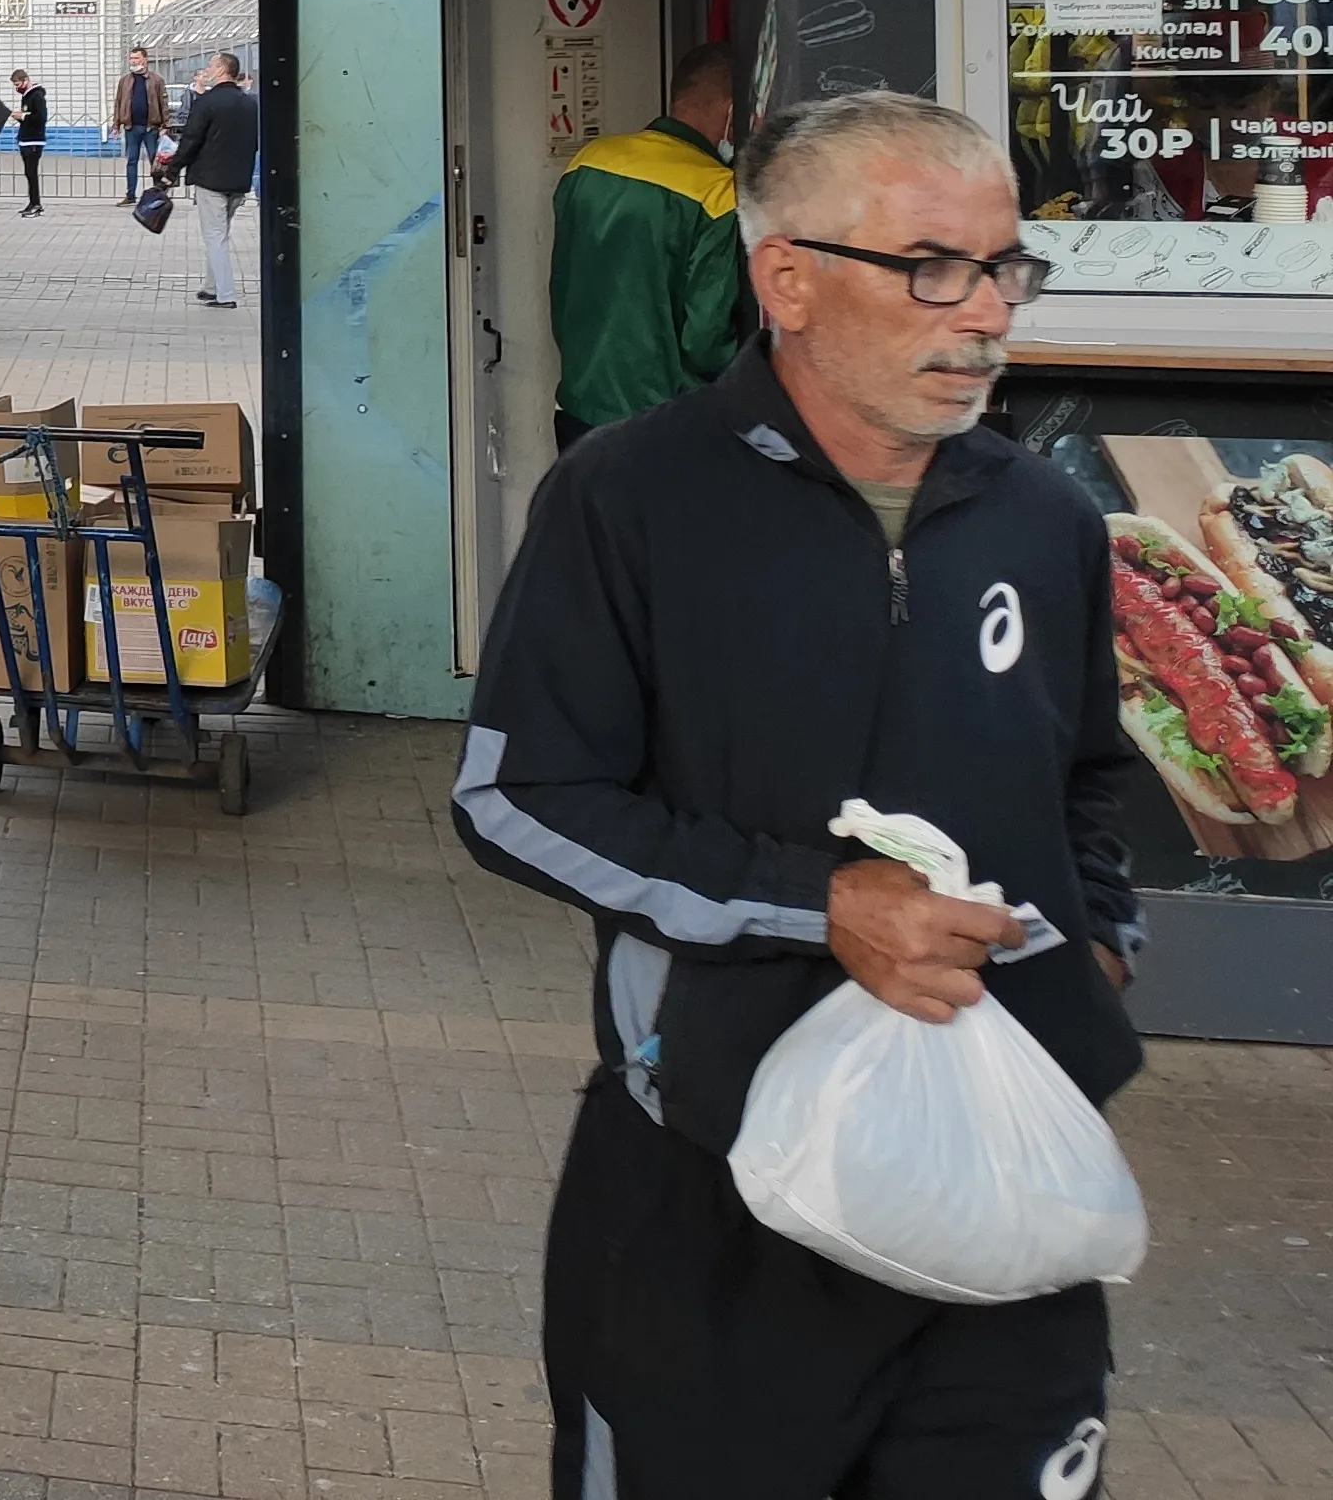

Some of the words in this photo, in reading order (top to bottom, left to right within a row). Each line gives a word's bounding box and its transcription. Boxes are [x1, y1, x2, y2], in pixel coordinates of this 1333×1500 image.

[1136, 44, 1223, 61] Кисель
[1050, 83, 1153, 125] Чай
[1231, 117, 1277, 134] Чай
[168, 587, 199, 598] ДЕНЬ
